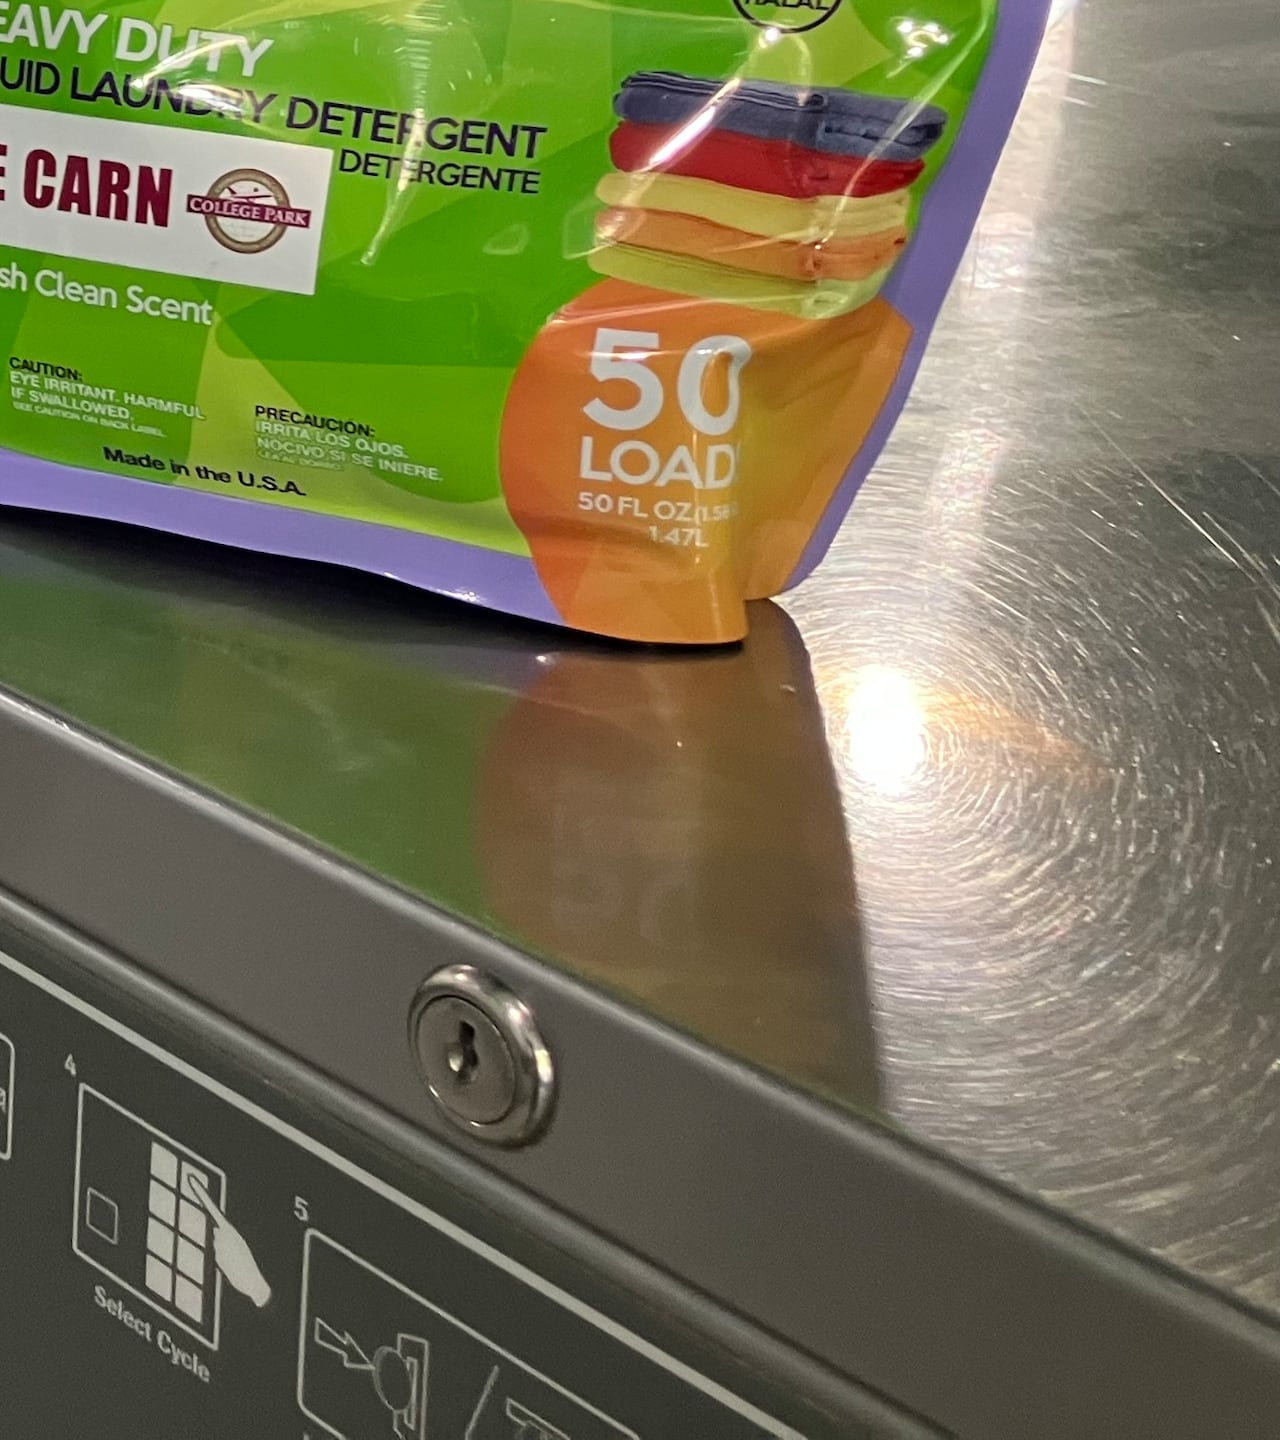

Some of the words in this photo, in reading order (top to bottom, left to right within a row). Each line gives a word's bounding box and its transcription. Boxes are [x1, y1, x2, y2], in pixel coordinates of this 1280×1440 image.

[115, 17, 275, 78] DUTY
[23, 149, 173, 228] CARN
[338, 148, 541, 195] DETERGENTE
[190, 196, 263, 220] COLLEGE
[264, 209, 310, 227] PARK
[34, 268, 118, 309] Clean
[125, 285, 213, 326] Scent
[9, 356, 83, 382] CAUTION:
[583, 327, 752, 436] 50
[10, 370, 41, 388] EYE
[43, 376, 121, 404] IRRITANT.
[123, 391, 205, 420] HARMFUL
[11, 386, 26, 400] IF
[255, 420, 311, 442] IRRITA
[315, 429, 352, 449] LOS
[354, 436, 409, 460] OJOS.
[256, 436, 326, 459] NOCIVO
[350, 452, 374, 467] SE
[378, 458, 445, 482] INIERE.
[102, 446, 165, 472] Made
[171, 460, 191, 478] in
[195, 466, 232, 484] the
[580, 436, 740, 490] LOAD
[578, 492, 614, 514] 50
[617, 495, 648, 518] FL
[653, 499, 692, 522] OZ
[648, 525, 710, 548] 1.47L
[63, 1052, 77, 1077] 4
[293, 1195, 310, 1222] 5
[94, 1285, 153, 1343] Select
[156, 1330, 211, 1384] Cycle
